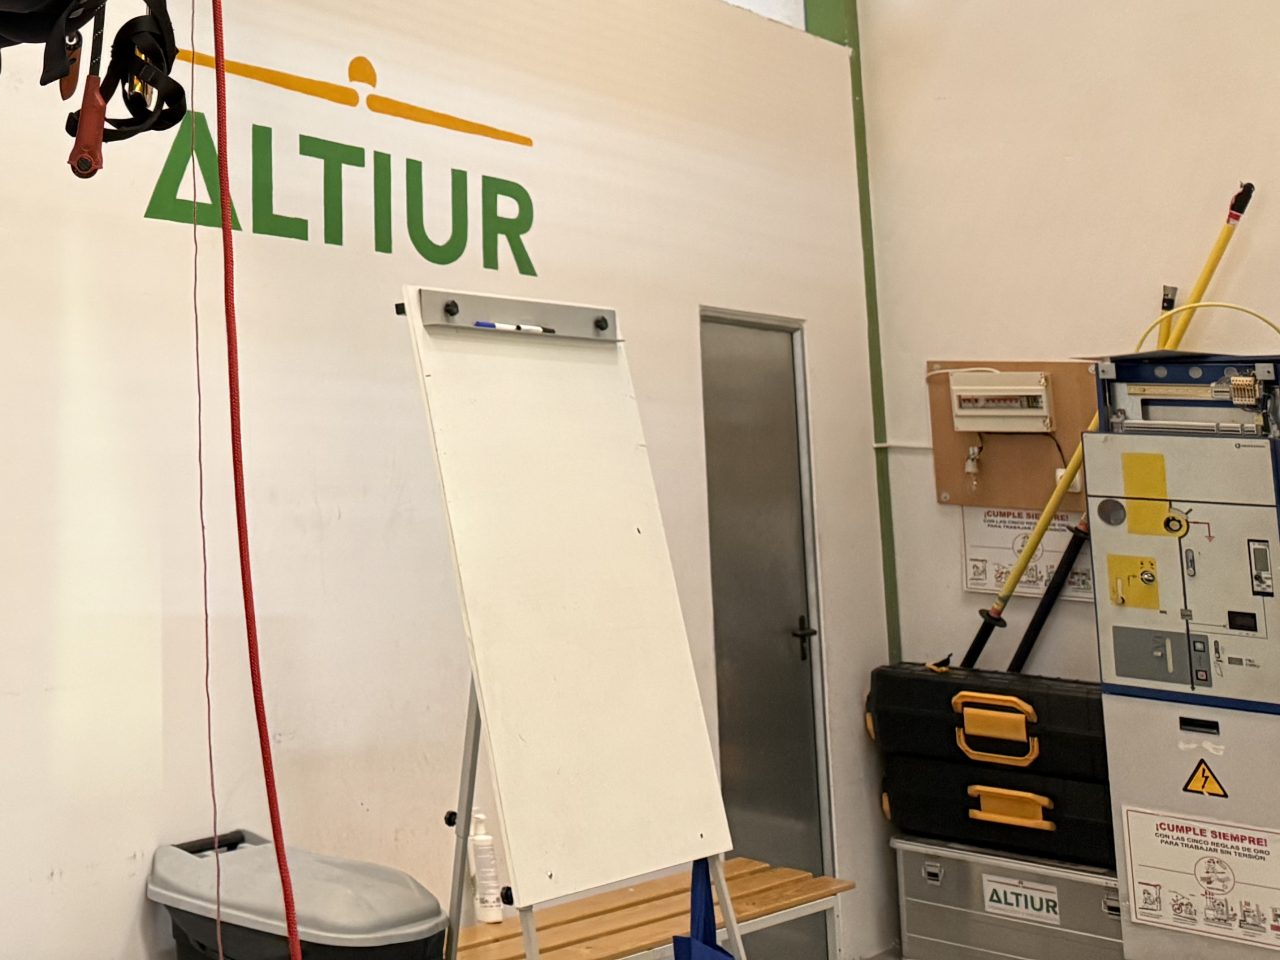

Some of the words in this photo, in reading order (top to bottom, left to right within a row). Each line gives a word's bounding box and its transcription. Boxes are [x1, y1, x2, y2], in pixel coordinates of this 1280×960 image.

[144, 109, 538, 277] ALTIUR
[1156, 822, 1207, 837] ¡CUMPLE
[1210, 830, 1268, 847] SIEMPRE!
[1160, 839, 1179, 847] PARA
[1180, 842, 1218, 853] TRABAJAR
[1171, 834, 1185, 842] LAS
[1187, 837, 1209, 846] CINCO
[1210, 841, 1240, 851] REGLAS
[989, 888, 1058, 915] ALTIUR
